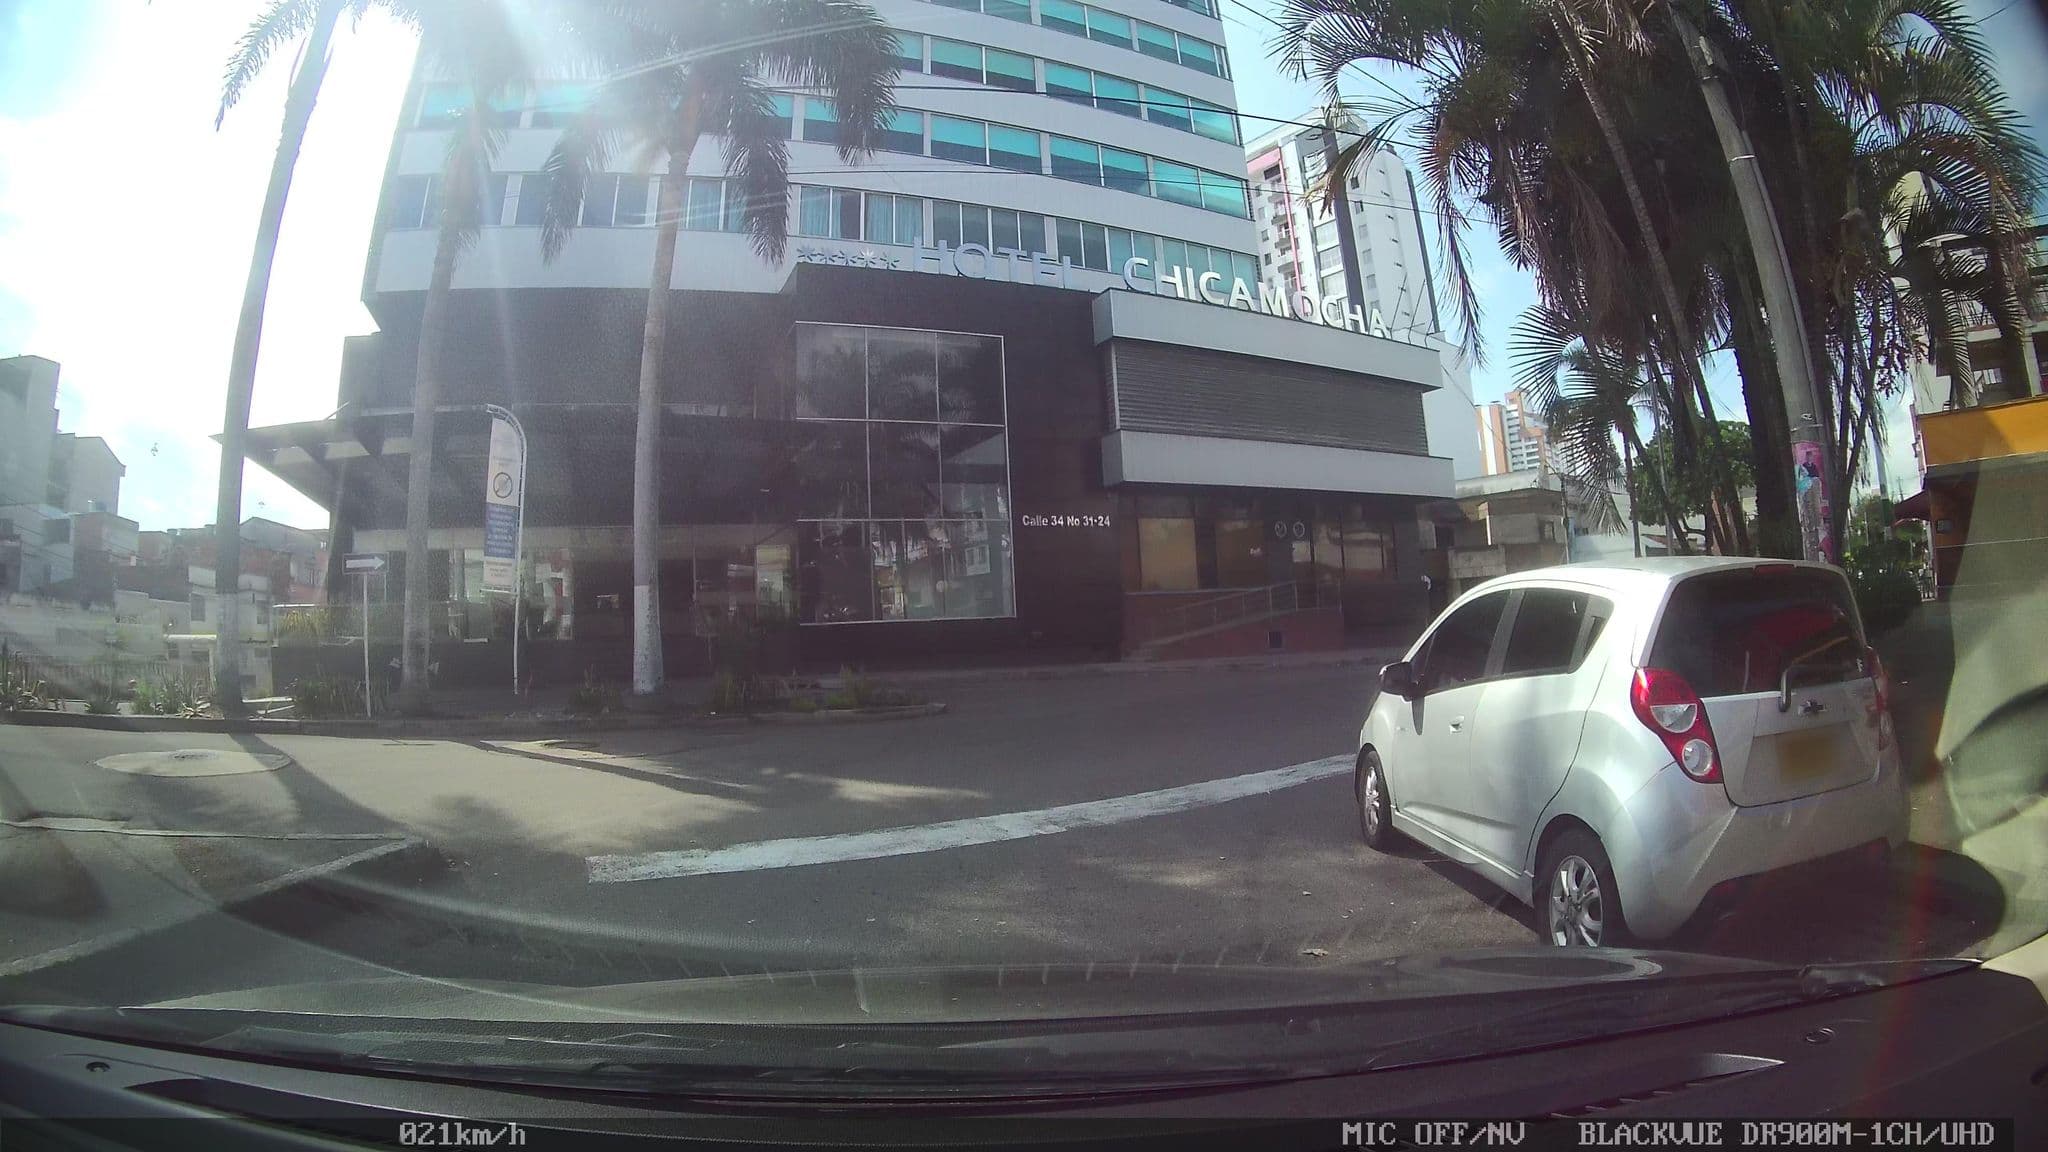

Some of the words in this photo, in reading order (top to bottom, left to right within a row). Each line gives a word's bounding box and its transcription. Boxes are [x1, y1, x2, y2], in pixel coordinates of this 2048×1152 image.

[913, 236, 1090, 293] HOTEL
[1123, 256, 1392, 340] CHICAMOCHA
[1022, 515, 1048, 527] Calle
[1051, 515, 1064, 527] 34
[1067, 515, 1080, 527] No
[1083, 515, 1110, 527] 31-24
